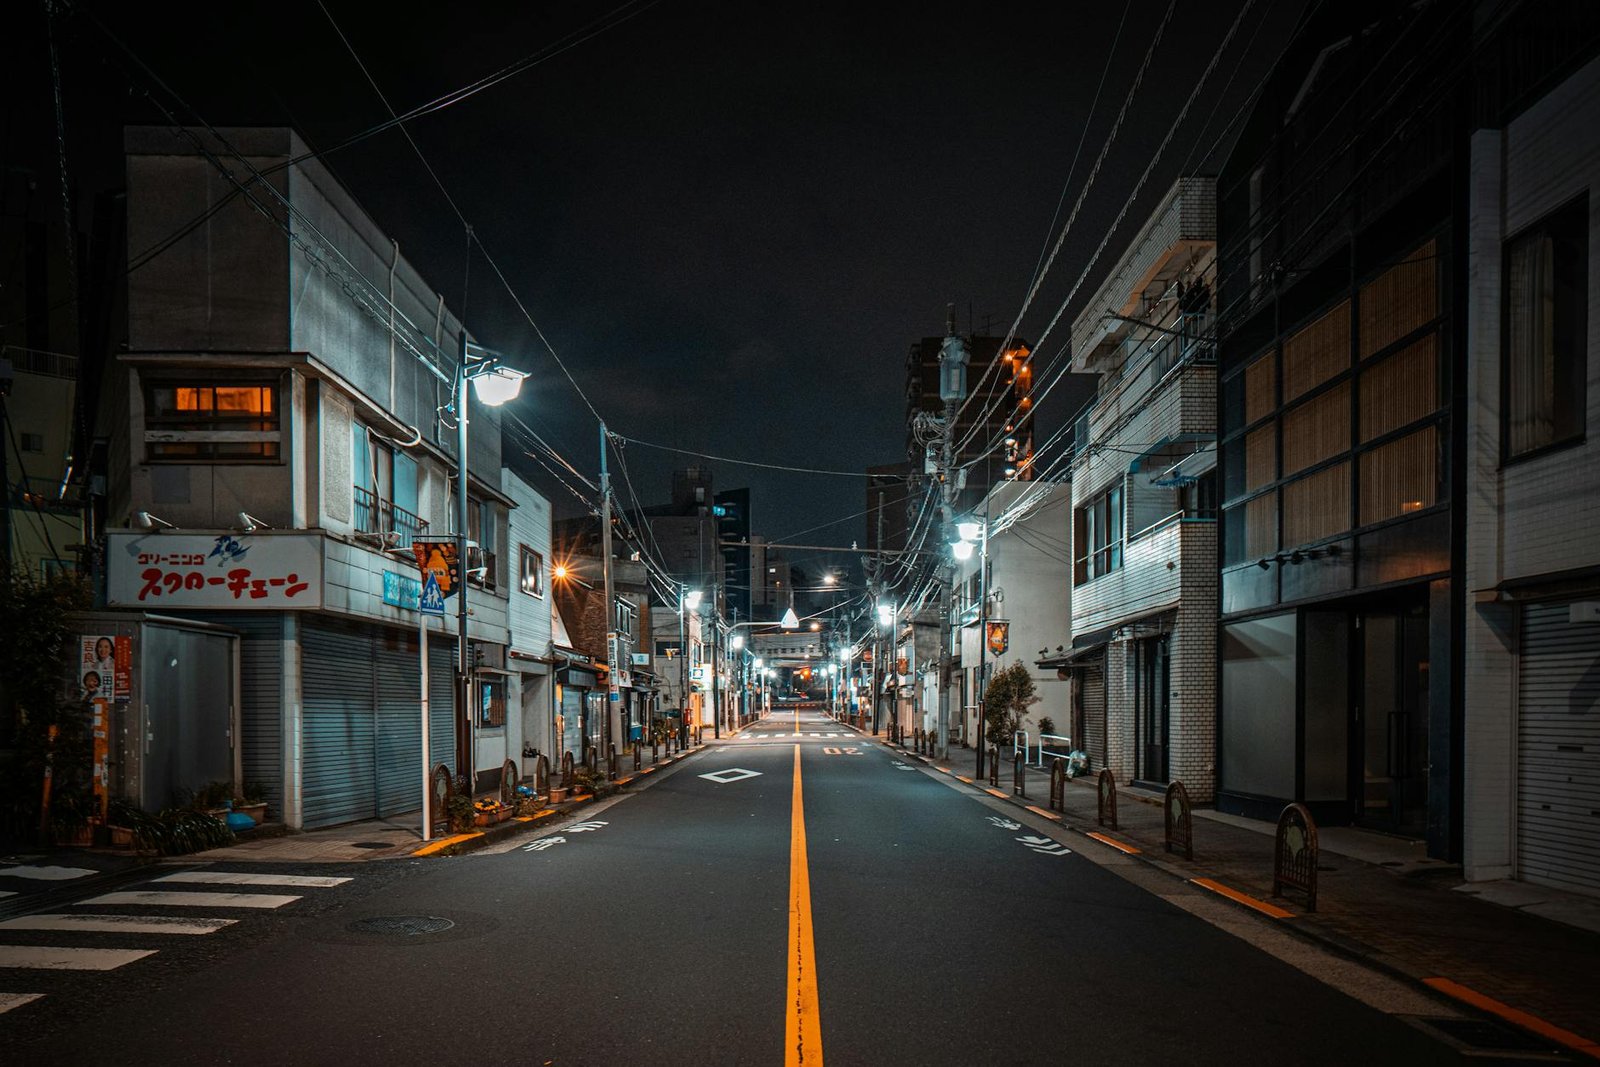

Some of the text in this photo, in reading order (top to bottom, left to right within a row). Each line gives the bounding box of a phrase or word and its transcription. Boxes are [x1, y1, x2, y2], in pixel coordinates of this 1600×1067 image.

[138, 553, 205, 565] クリーニング
[83, 640, 96, 664] 吉良
[102, 675, 113, 697] 田村
